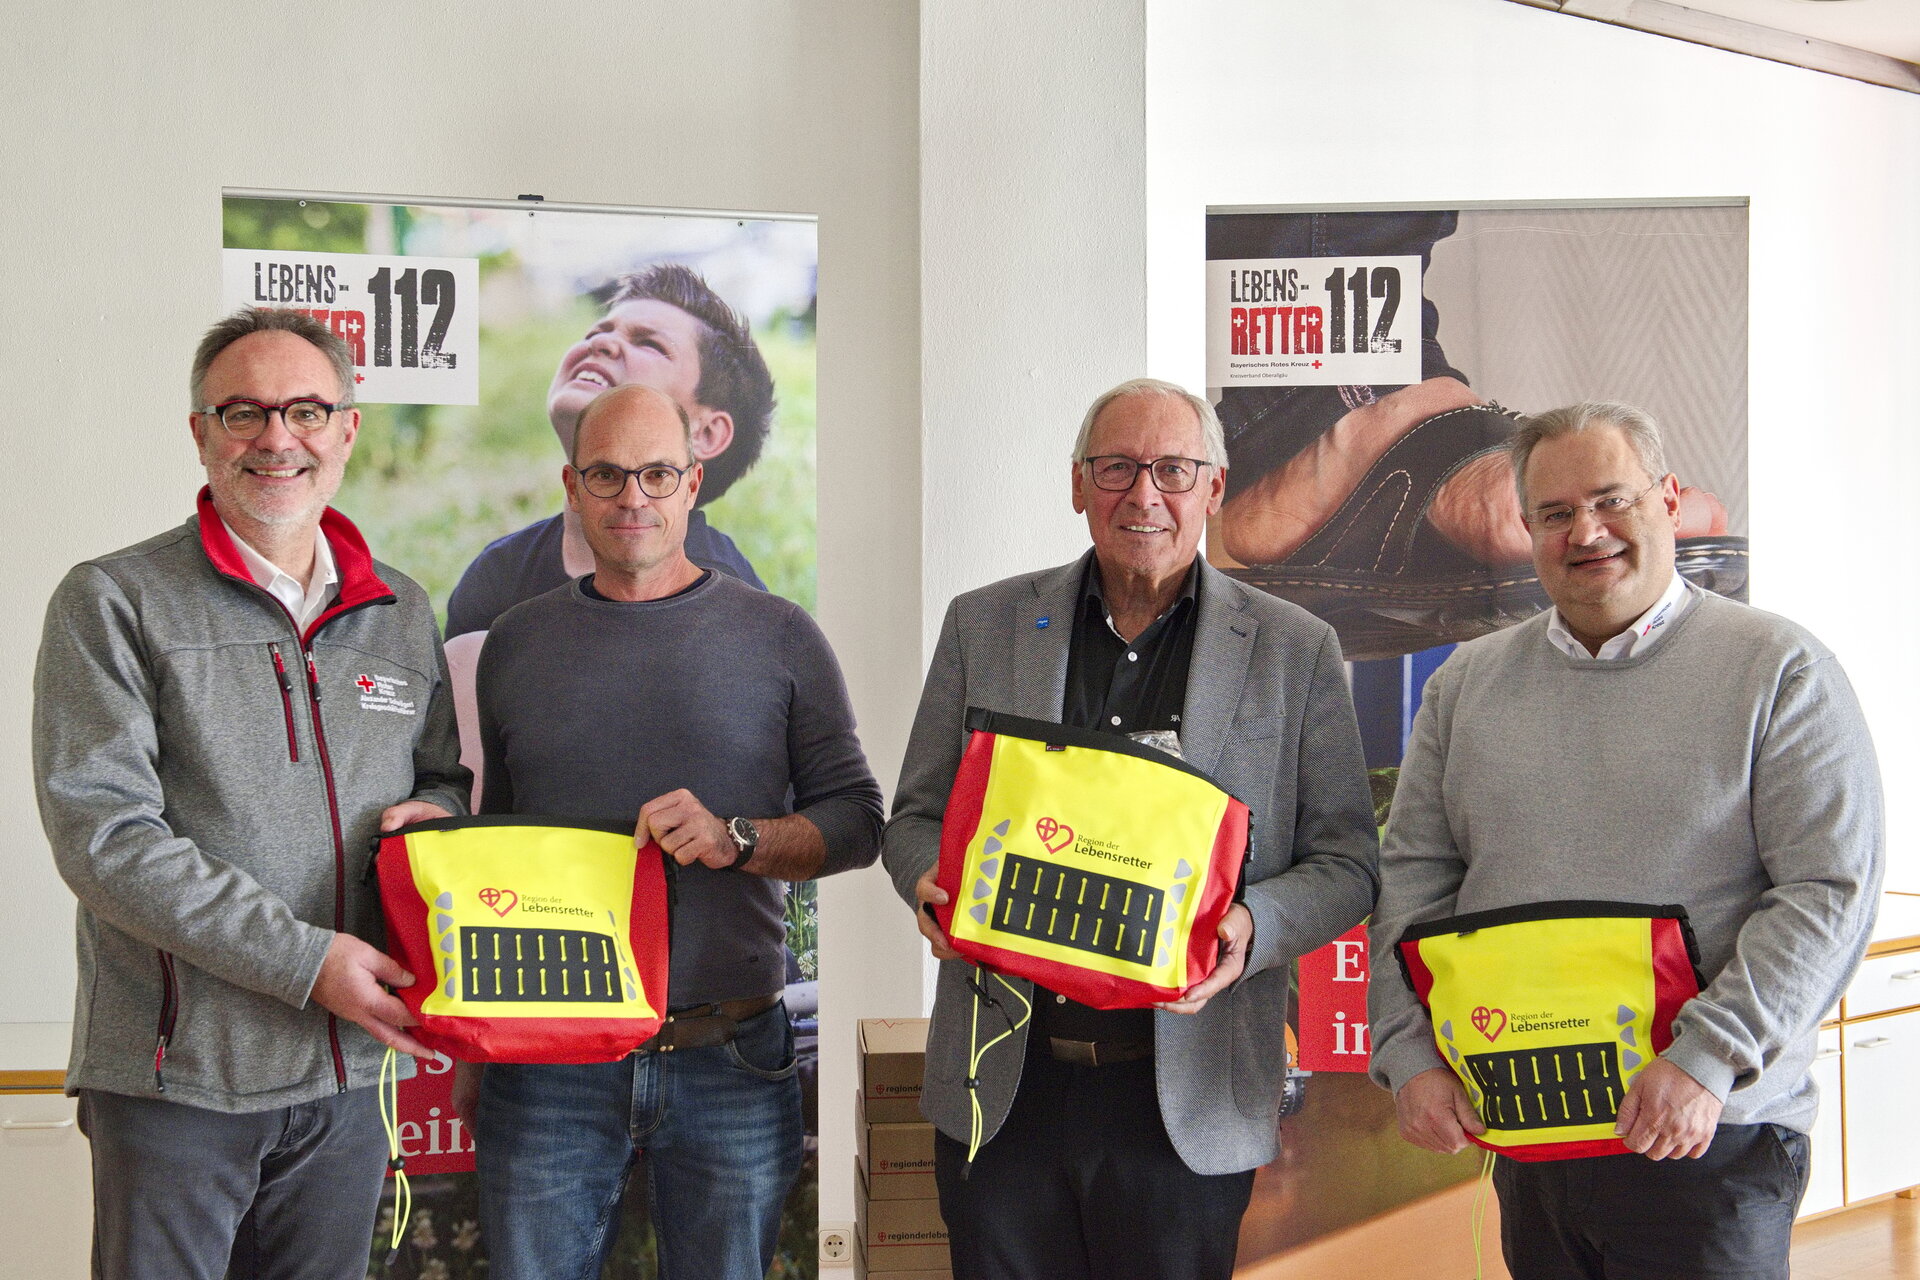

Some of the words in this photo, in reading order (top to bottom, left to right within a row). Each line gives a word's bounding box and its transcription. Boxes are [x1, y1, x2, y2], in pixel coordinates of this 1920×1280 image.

[255, 262, 349, 304] LEBENS-
[1231, 268, 1309, 303] LEBENS-
[367, 267, 457, 369] 112
[1325, 266, 1402, 354] 112
[1231, 306, 1324, 355] RETTER
[1074, 843, 1153, 870] Lebensretter
[1077, 834, 1104, 847] Region
[1106, 840, 1120, 851] der
[522, 894, 548, 903] Region
[522, 902, 594, 918] Lebensretter
[1332, 940, 1369, 982] E
[1510, 1012, 1538, 1022] Region
[1540, 1011, 1554, 1019] der
[1510, 1017, 1591, 1033] Lebensretter
